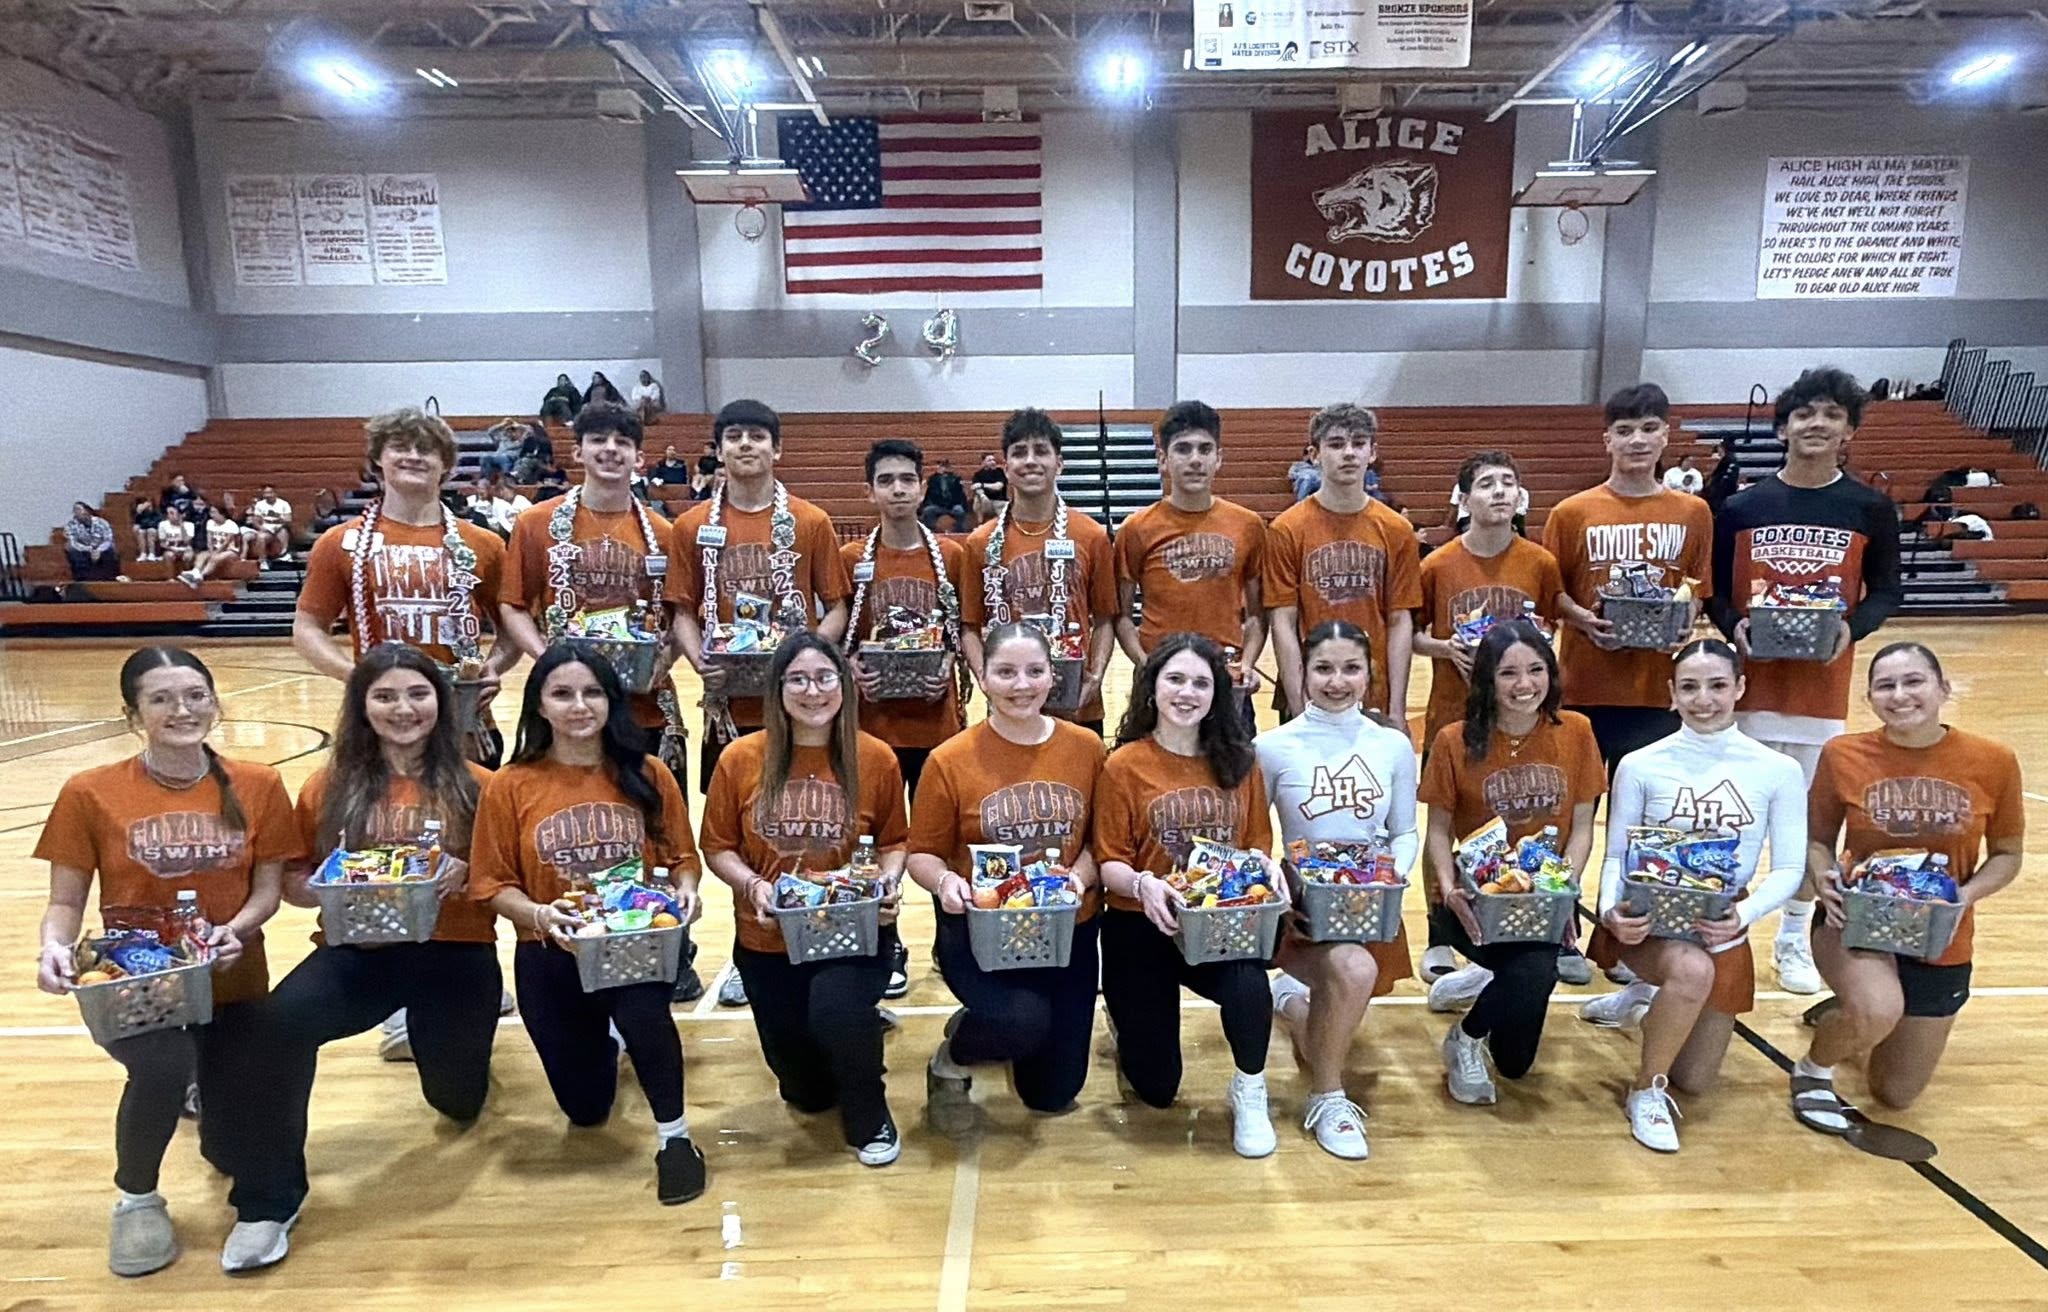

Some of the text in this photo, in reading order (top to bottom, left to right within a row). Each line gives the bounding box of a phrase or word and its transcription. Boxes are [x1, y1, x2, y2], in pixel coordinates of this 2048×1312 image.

[1378, 4, 1416, 13] BRONZE
[1323, 41, 1359, 54] STX
[1305, 117, 1464, 156] ALICE
[1780, 160, 1822, 172] ALICE
[1827, 160, 1862, 172] HIGH
[1867, 160, 1906, 171] ALMA
[1790, 175, 1816, 187] HAIL
[1819, 175, 1850, 187] ALICE
[1884, 174, 1905, 186] THE
[1775, 191, 1793, 203] WE
[1795, 191, 1821, 203] LOVE
[1823, 191, 1838, 203] SO
[1875, 190, 1911, 202] WHERE
[1914, 190, 1958, 202] FRIENDS
[1821, 206, 1846, 218] MET
[1879, 206, 1901, 217] NOT
[1904, 205, 1945, 218] FORGET
[1777, 222, 1848, 234] THROUGHOUT
[1850, 222, 1869, 233] THE
[1871, 221, 1914, 233] COMING
[1763, 238, 1777, 249] SO
[1779, 237, 1817, 249] HERE'S
[1820, 237, 1833, 248] TO
[1834, 237, 1855, 248] THE
[1857, 237, 1901, 248] ORANGE
[1902, 236, 1926, 247] AND
[1773, 253, 1793, 264] THE
[1795, 253, 1836, 264] COLORS
[1837, 253, 1859, 263] FOR
[1861, 252, 1897, 263] WHICH
[1899, 252, 1915, 262] WE
[1285, 241, 1475, 293] COYOTES
[1763, 267, 1955, 279] LET'S PLEDGE ANEW AND ALL BE TRUE
[1795, 283, 1808, 294] TO
[1810, 283, 1838, 294] DEAR
[1839, 283, 1861, 294] OLD
[1861, 282, 1892, 293] ALICE
[1586, 523, 1645, 562] COYOTE
[1752, 525, 1852, 549] COYOTES
[1754, 547, 1840, 560] BASKETBALL
[1172, 558, 1225, 569] SWIM
[574, 573, 635, 586] SWIM
[1319, 575, 1374, 588] SWIM
[1312, 766, 1375, 819] AHS
[1496, 796, 1558, 811] SWIM
[1875, 808, 1957, 824] SWIM
[763, 821, 843, 838] SWIM
[997, 822, 1073, 841] SWIM
[143, 844, 229, 860] SWIM
[554, 844, 635, 865] SWIM
